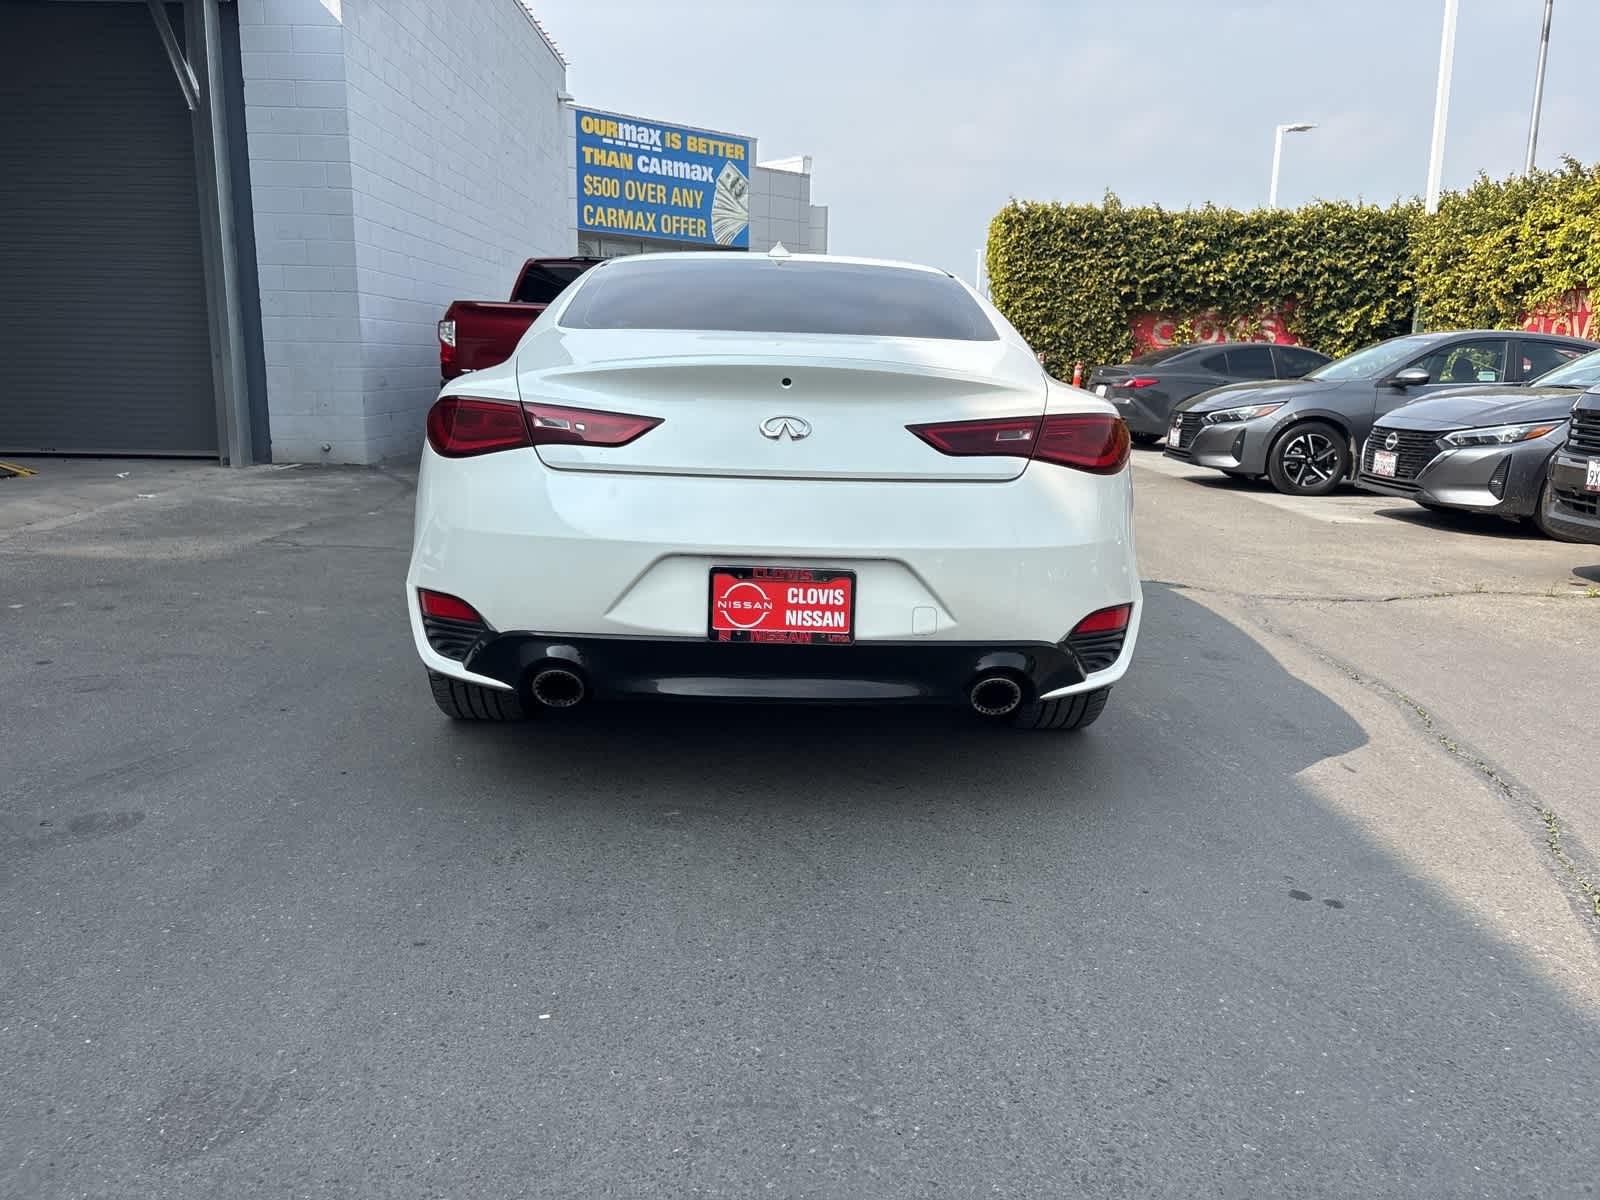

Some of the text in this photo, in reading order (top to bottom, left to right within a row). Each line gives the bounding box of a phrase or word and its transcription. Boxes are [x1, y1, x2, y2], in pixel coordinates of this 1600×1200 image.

[665, 132, 681, 149] IS
[687, 137, 745, 160] BETTER
[582, 147, 633, 170] THAN
[583, 174, 704, 209] $500 OVER ANY
[583, 205, 706, 238] CARMAX OFFER
[717, 600, 773, 609] NISSAN
[787, 587, 845, 606] CLOVIS
[785, 610, 845, 627] NISSAN
